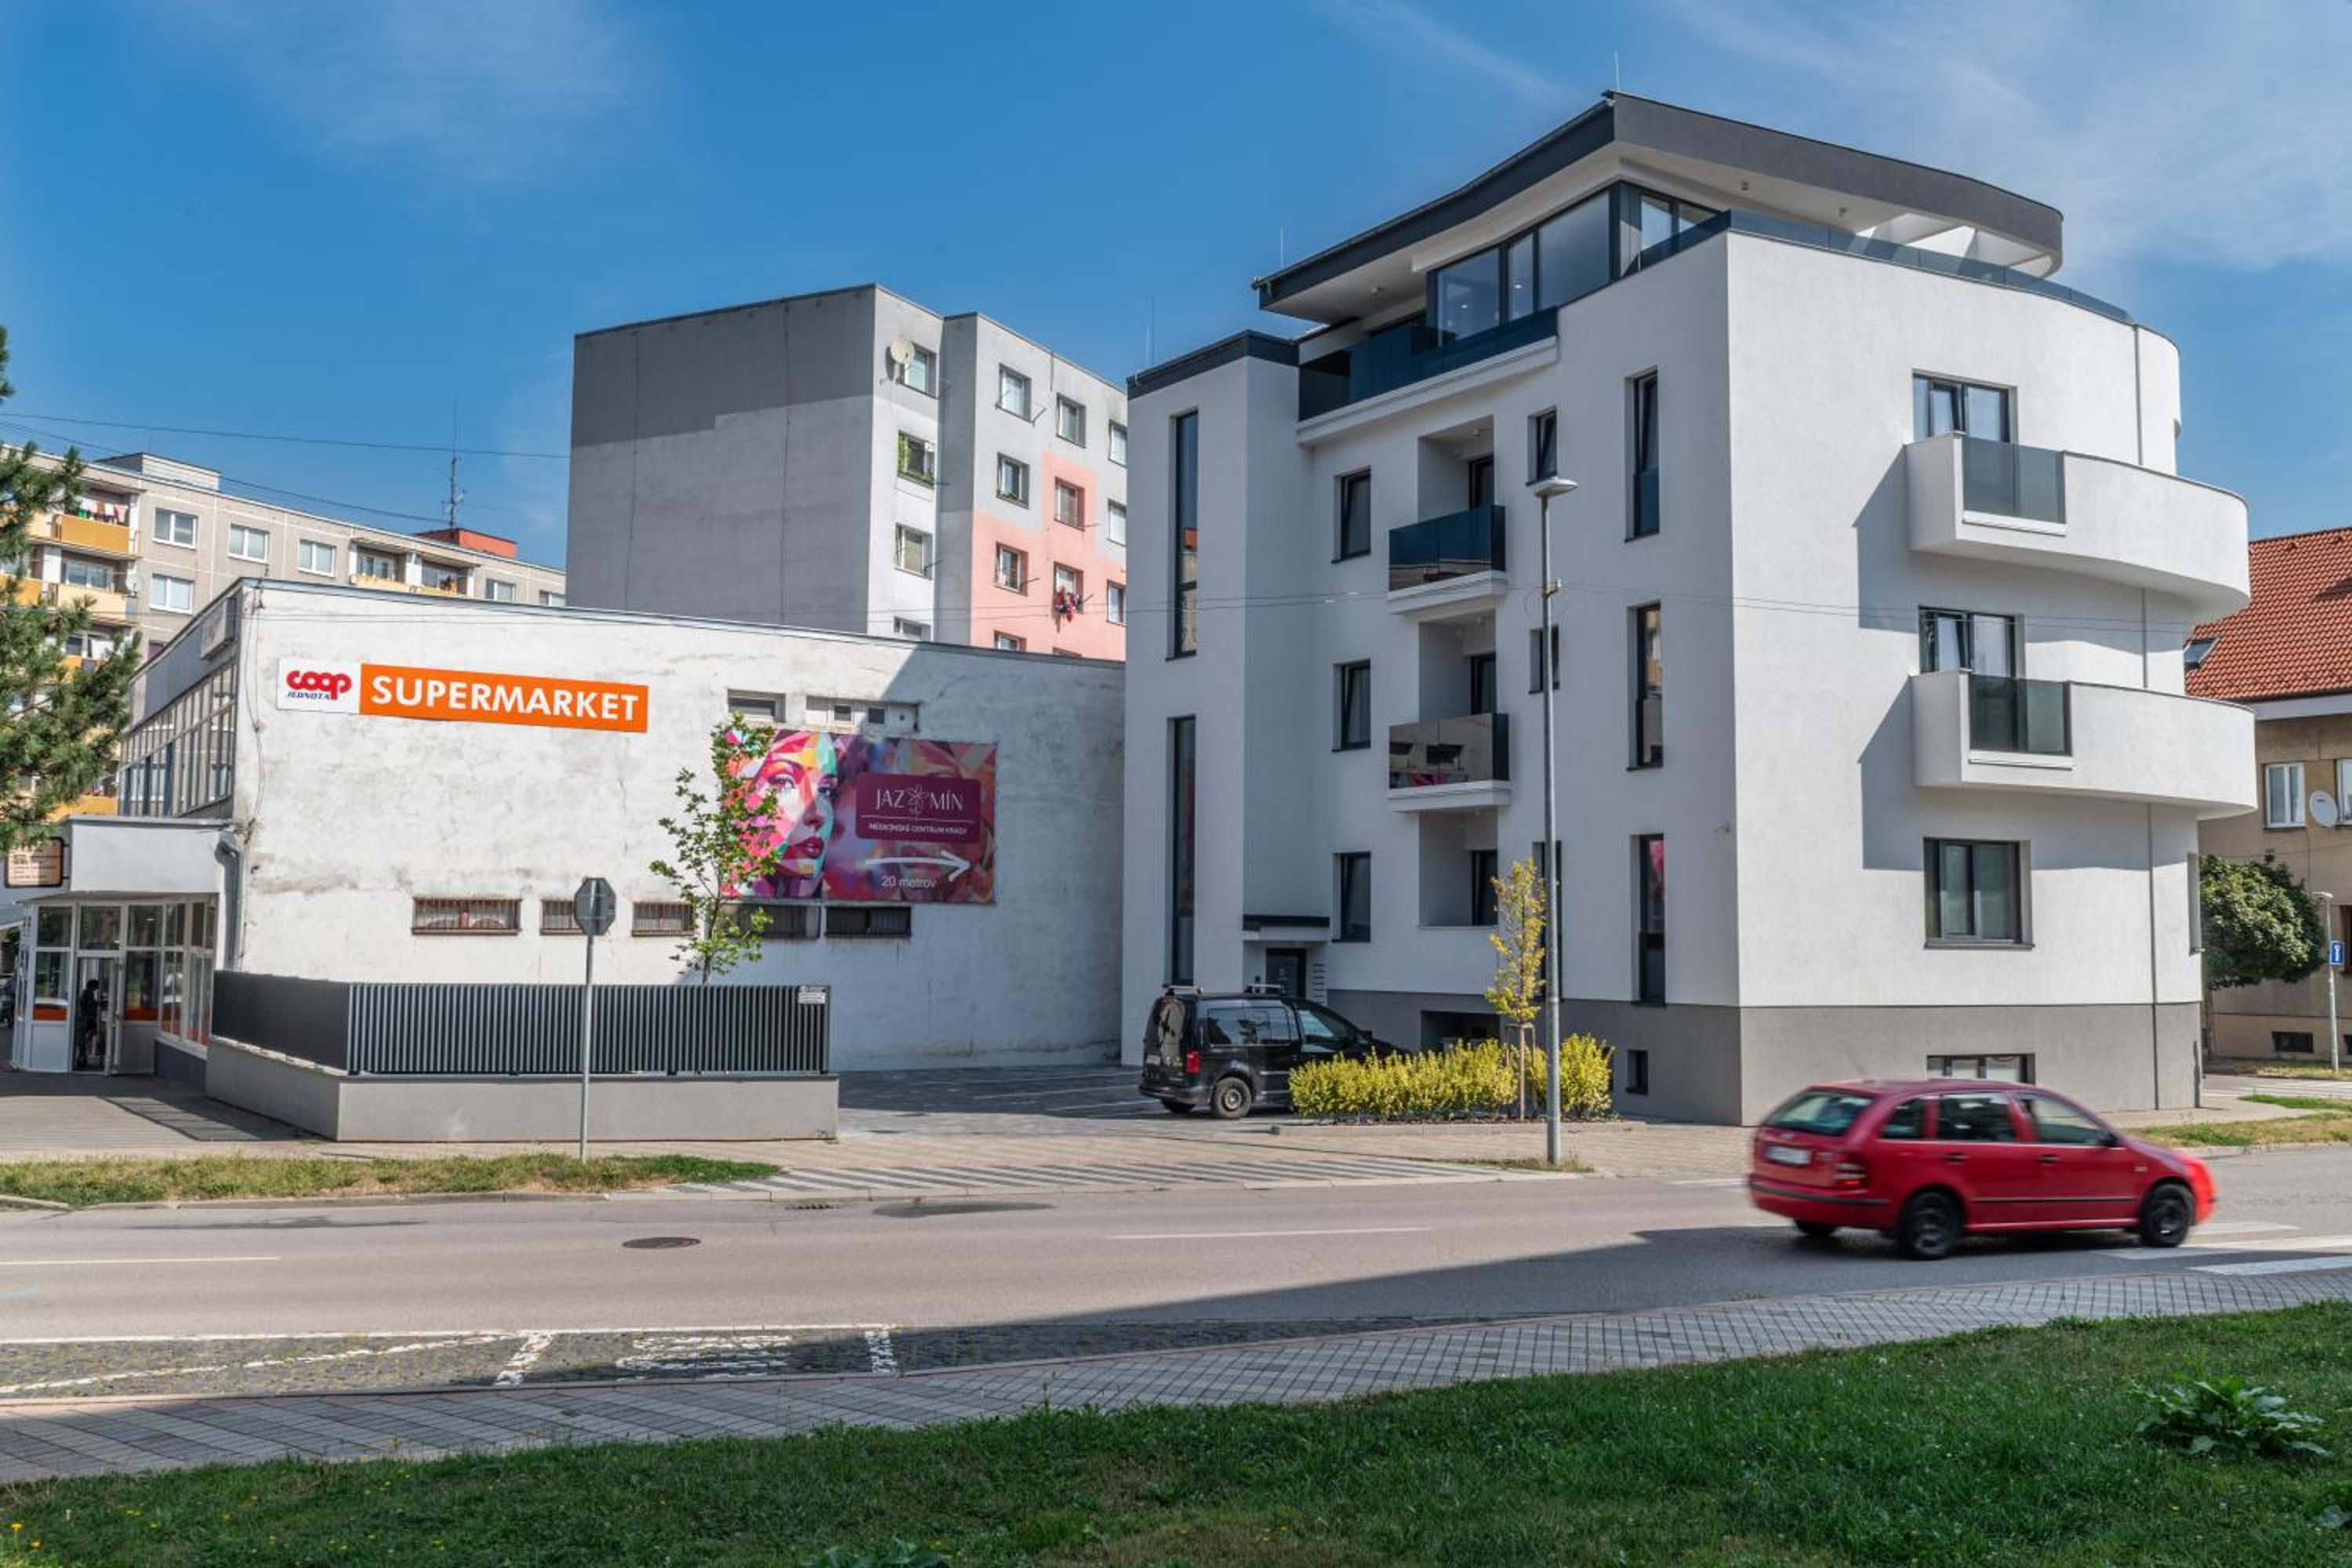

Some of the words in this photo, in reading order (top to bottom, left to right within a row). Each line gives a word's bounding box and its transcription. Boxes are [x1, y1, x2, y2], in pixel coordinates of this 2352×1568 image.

[371, 675, 640, 721] SUPERMARKET
[881, 875, 897, 887] 20
[898, 877, 937, 888] metrov
